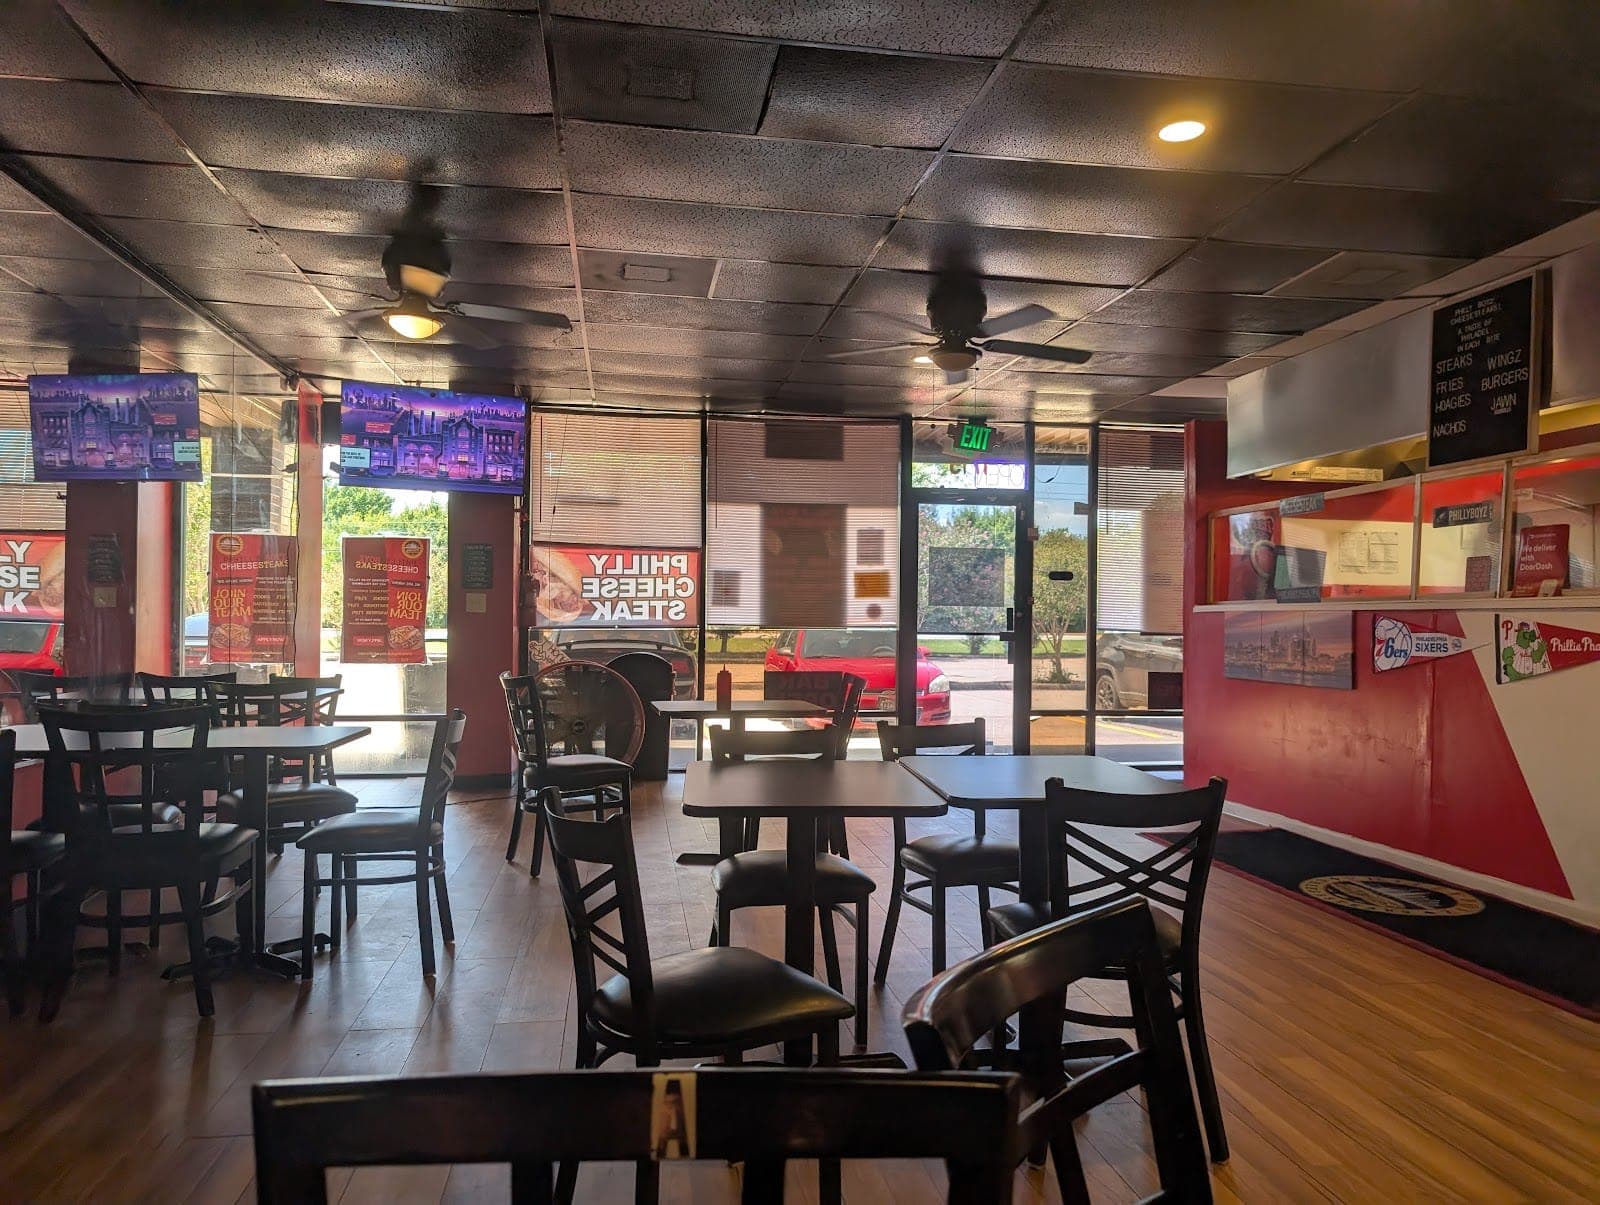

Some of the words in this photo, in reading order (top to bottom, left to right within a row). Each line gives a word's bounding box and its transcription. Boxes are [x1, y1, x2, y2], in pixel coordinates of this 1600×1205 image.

[1436, 353, 1473, 375] STEAKS
[1487, 348, 1522, 371] WINGZ
[1436, 376, 1464, 395] FRIES
[1481, 367, 1529, 391] BURGERS
[1434, 393, 1472, 413] HOAGIES
[1490, 392, 1517, 411] JAWN
[960, 425, 992, 450] EXIT
[1432, 419, 1467, 438] NACHOS
[1448, 504, 1488, 521] PHILLYBOYZ
[1533, 543, 1557, 552] deliver
[1520, 562, 1553, 571] DoorDash
[214, 588, 246, 599] JOIN
[214, 606, 252, 618] TEAM
[1501, 620, 1513, 640] P
[1375, 637, 1409, 659] 76ers
[1414, 642, 1449, 653] SIXERS
[1550, 637, 1582, 652] Phillie
